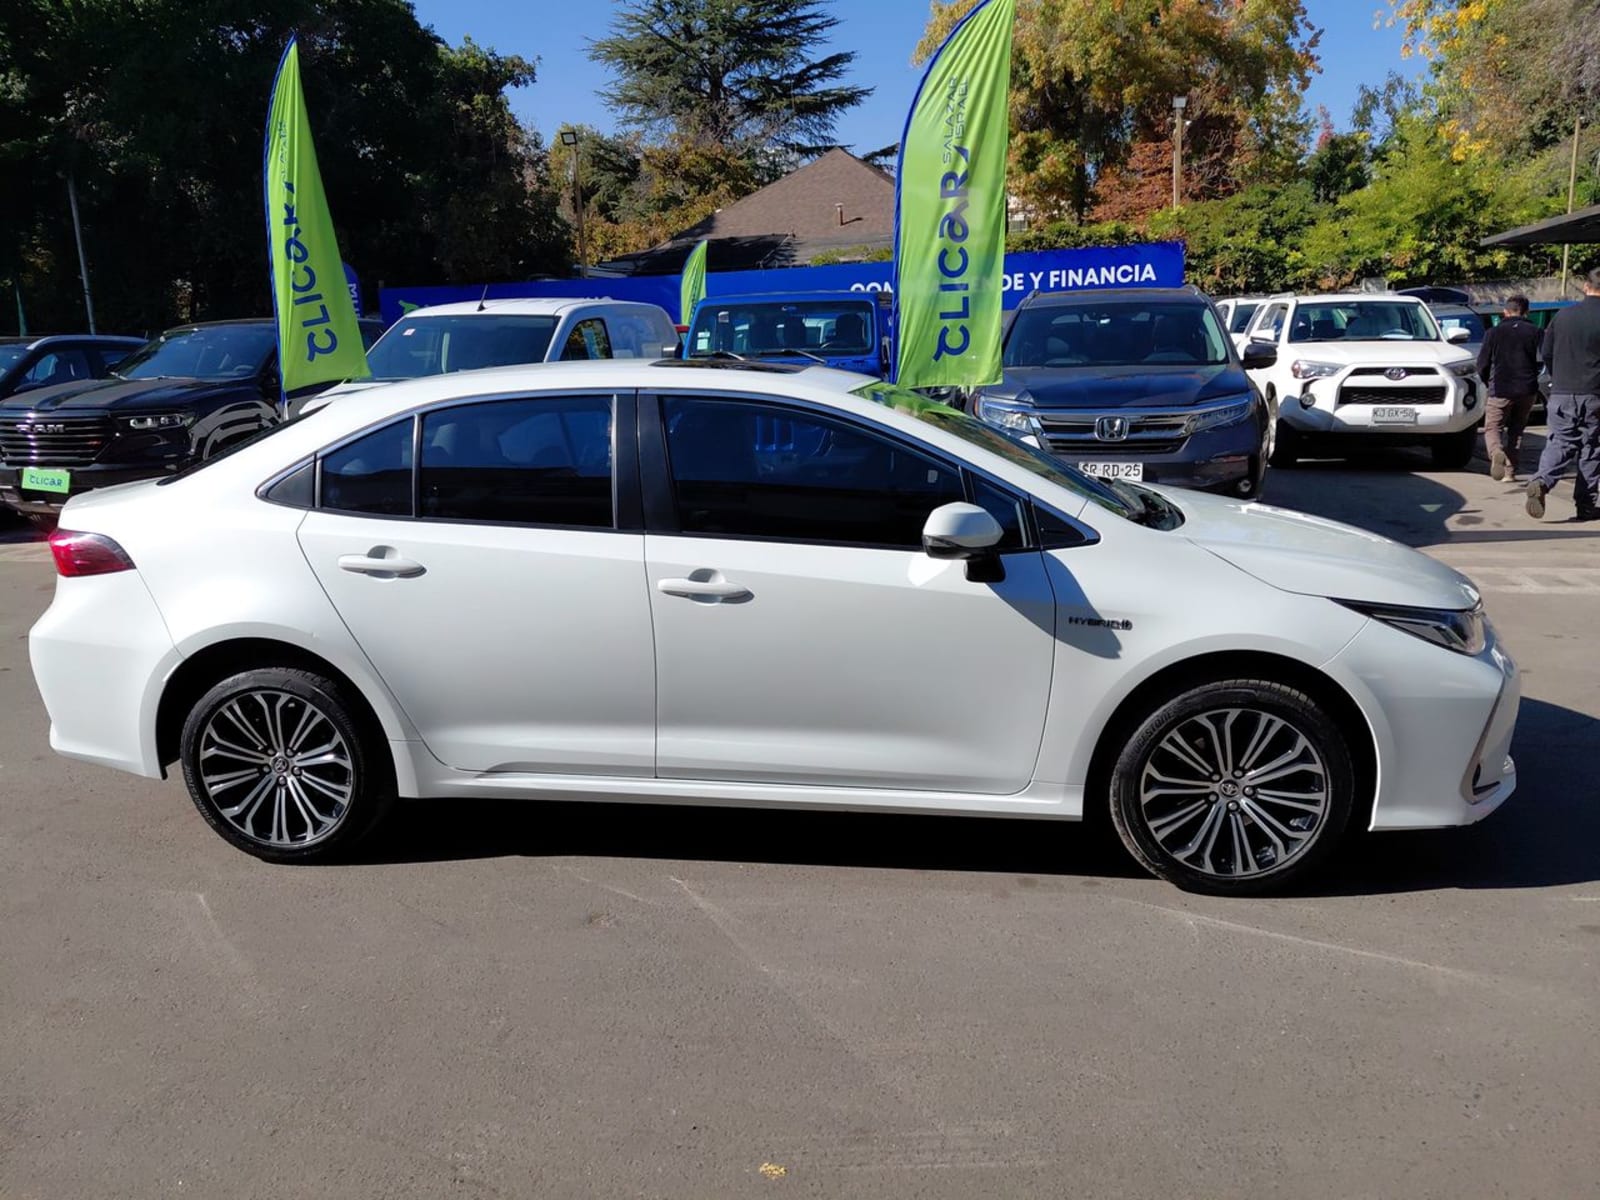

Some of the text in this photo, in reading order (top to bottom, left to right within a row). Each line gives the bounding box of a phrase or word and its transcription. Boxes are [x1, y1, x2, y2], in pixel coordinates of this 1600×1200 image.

[1029, 271, 1044, 290] Y
[1049, 263, 1157, 289] FINANCIA
[1068, 616, 1121, 631] HYBRID
